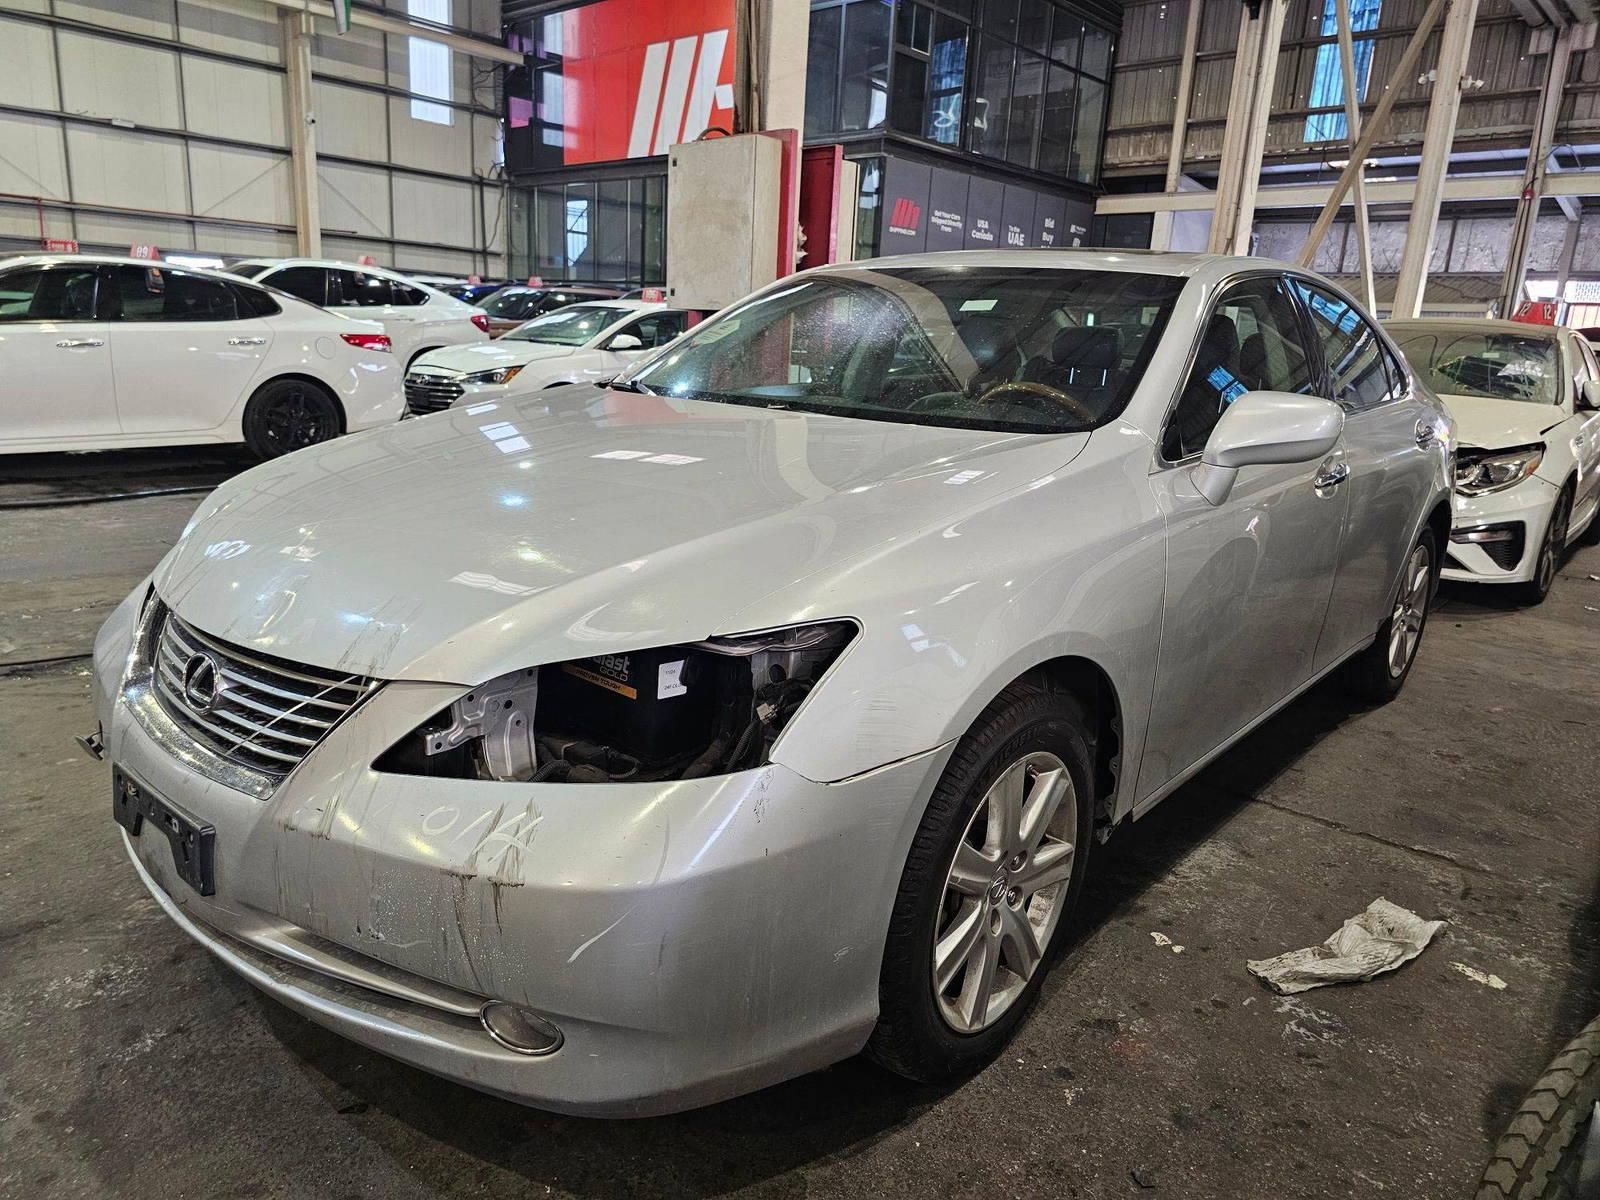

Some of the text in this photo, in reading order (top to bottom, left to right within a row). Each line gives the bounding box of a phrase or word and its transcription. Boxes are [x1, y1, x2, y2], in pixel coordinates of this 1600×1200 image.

[977, 219, 989, 229] USA
[971, 229, 994, 241] Canada
[1007, 232, 1025, 246] UAE
[1042, 232, 1054, 245] Buy
[600, 665, 628, 681] GOLD
